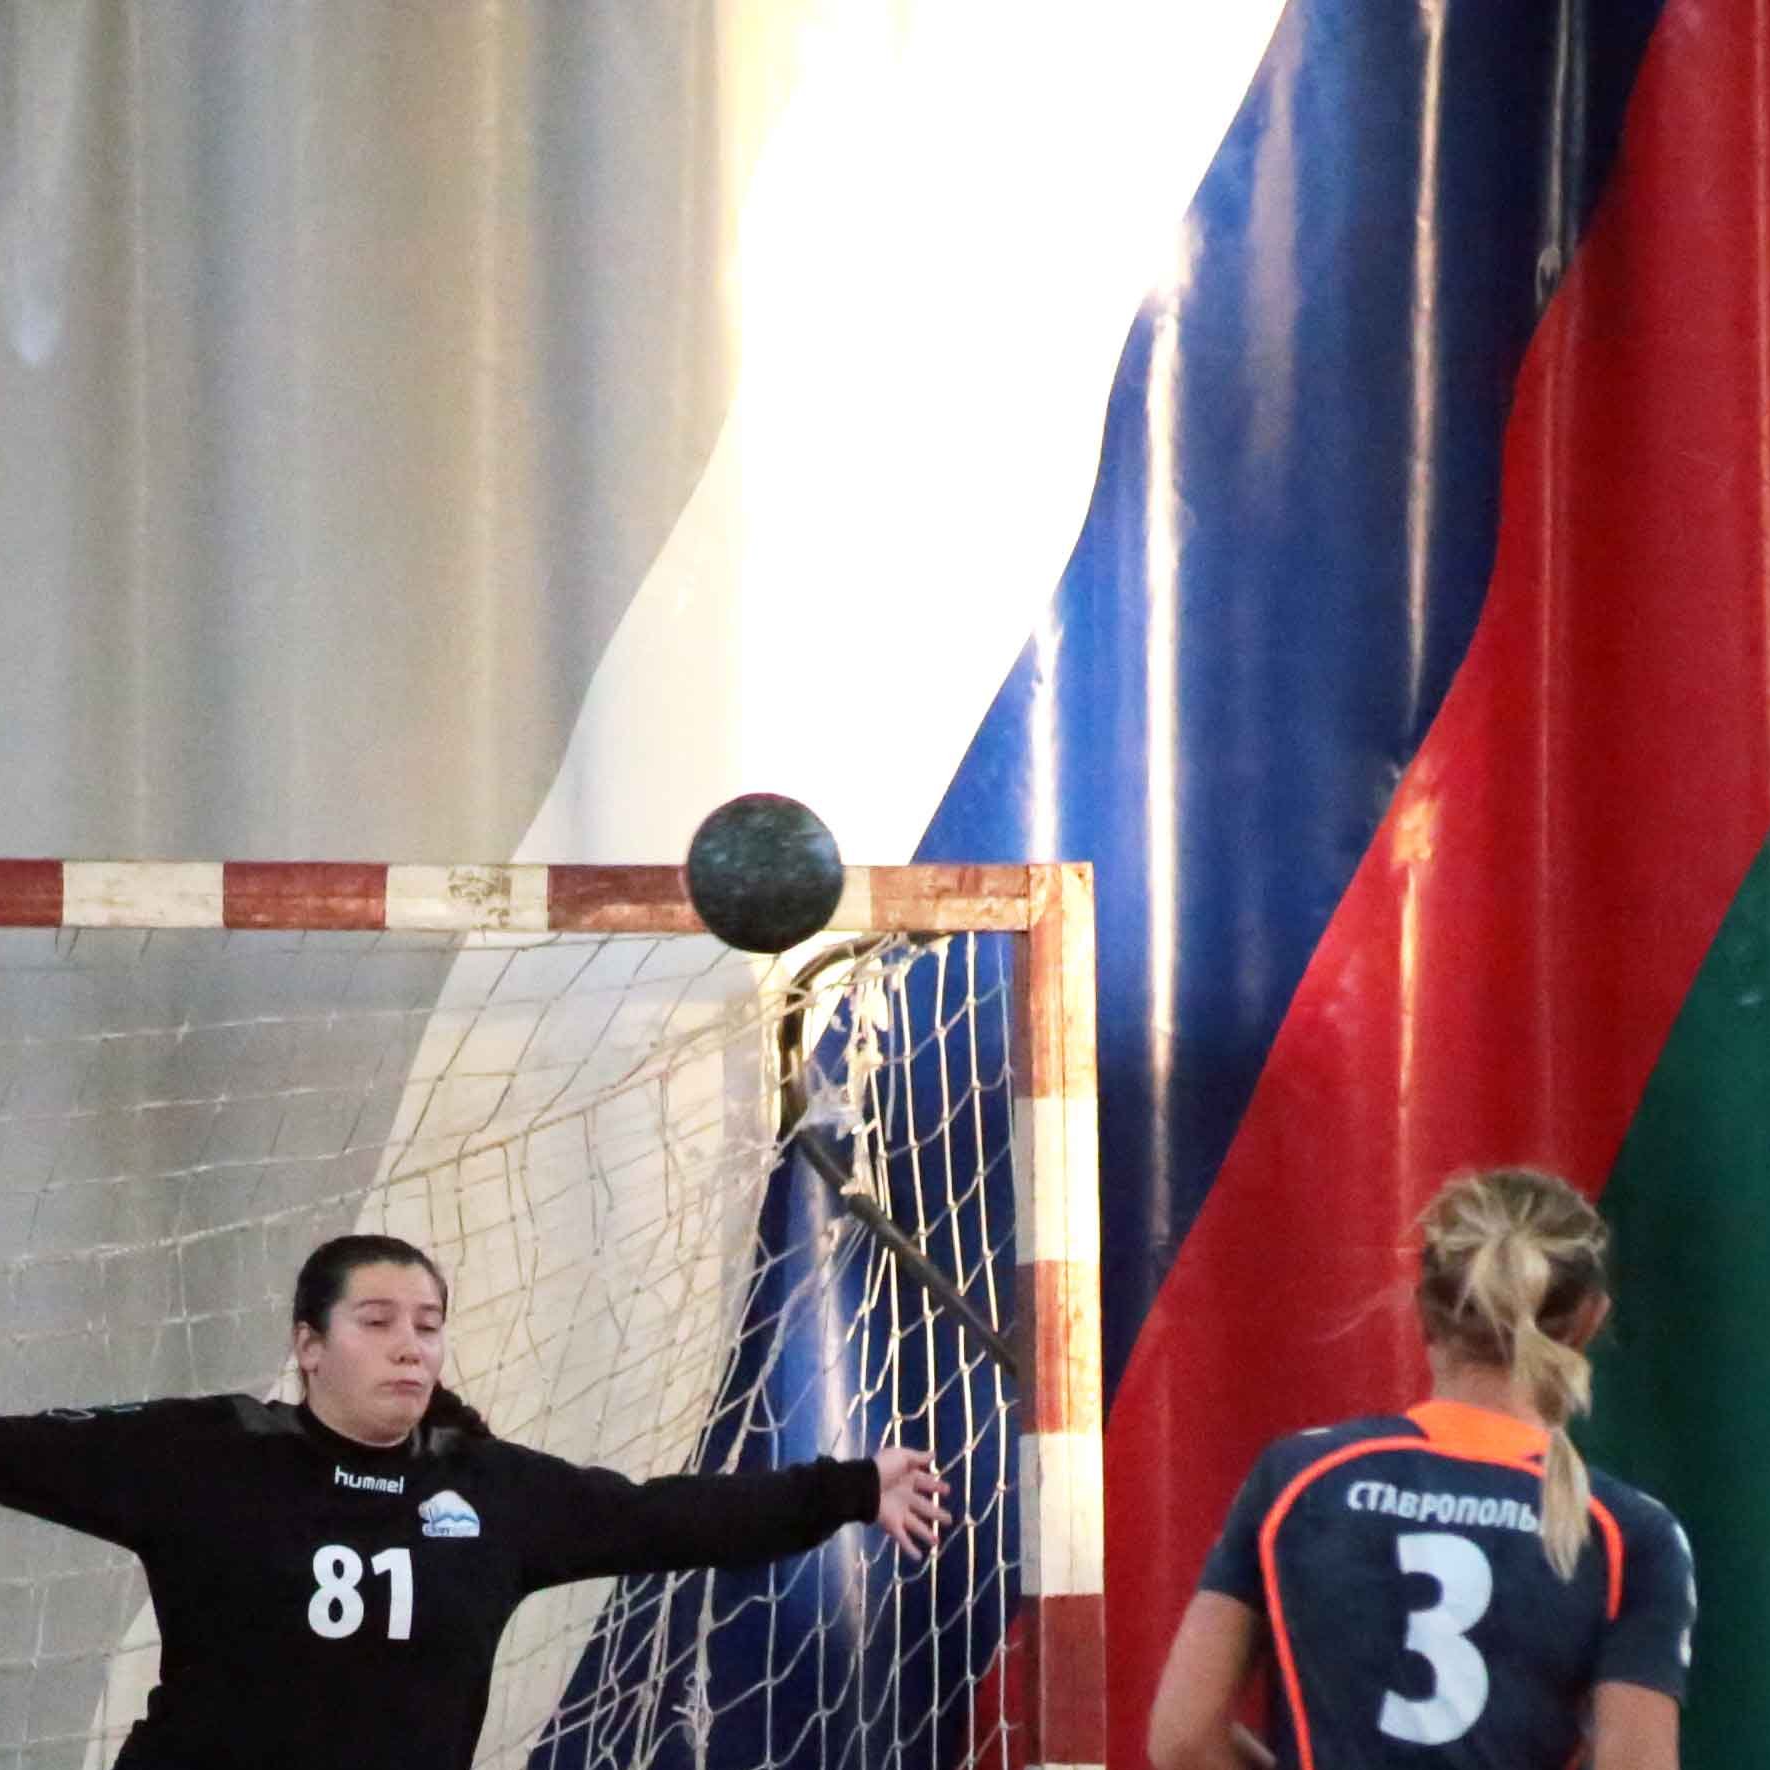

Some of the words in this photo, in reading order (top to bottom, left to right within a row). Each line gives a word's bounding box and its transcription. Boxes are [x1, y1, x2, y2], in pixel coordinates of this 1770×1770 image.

[334, 1465, 405, 1495] hummel
[1347, 1480, 1546, 1536] СТАВРОПОЛЬ
[307, 1544, 414, 1640] 81
[1377, 1532, 1493, 1745] 3
